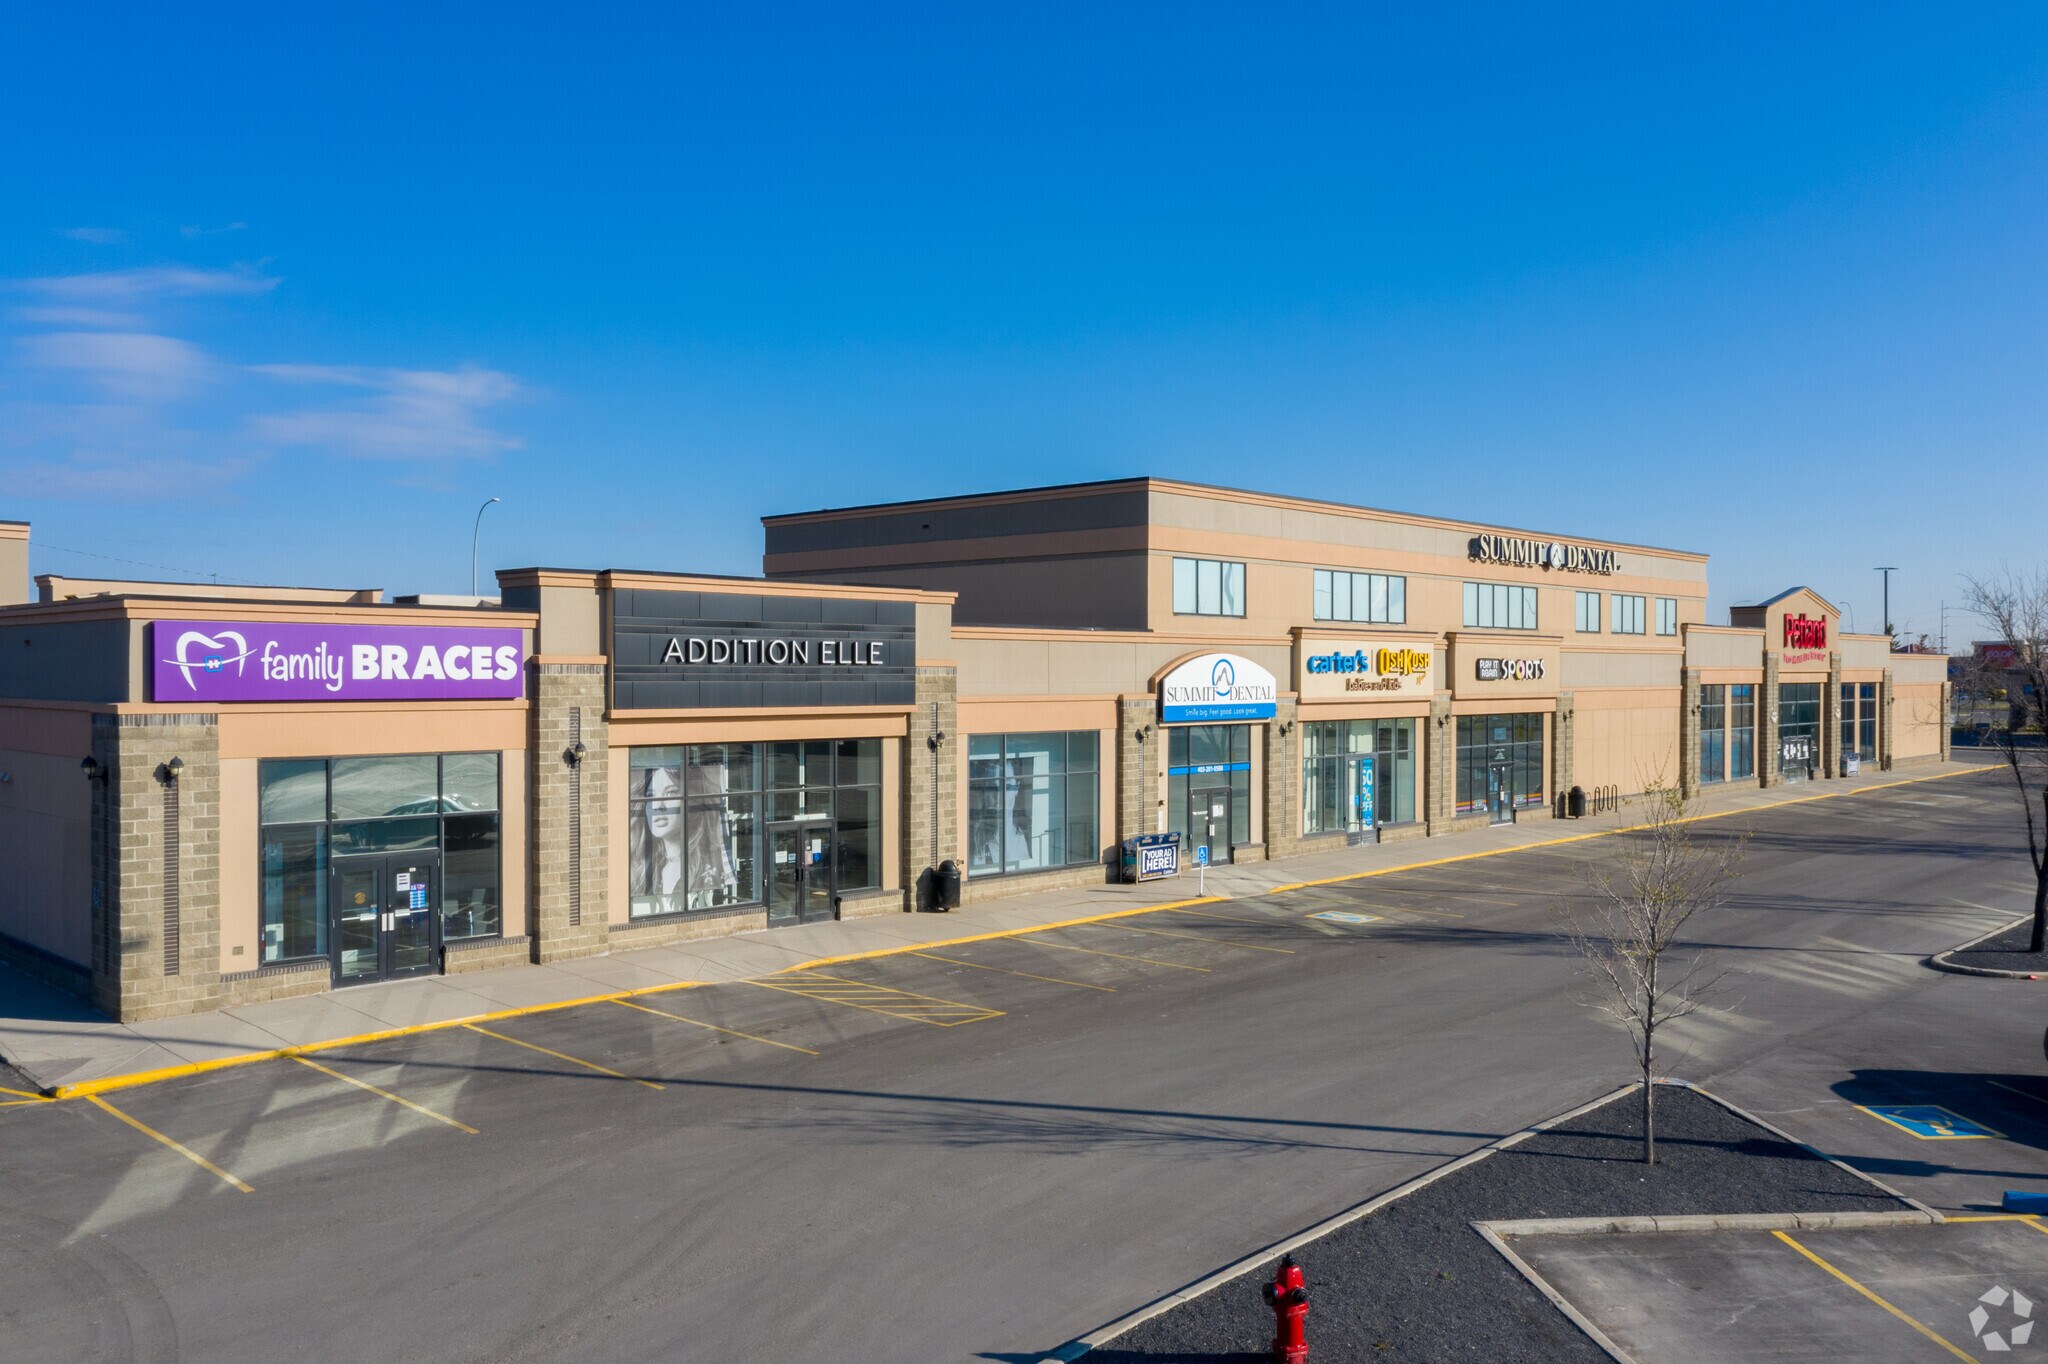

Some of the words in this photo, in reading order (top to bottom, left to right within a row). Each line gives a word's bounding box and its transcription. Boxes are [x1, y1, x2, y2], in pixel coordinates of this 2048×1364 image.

[1480, 533, 1546, 565] SUMMIT
[1567, 545, 1622, 573] DENTAL
[1783, 613, 1827, 650] Petland
[664, 637, 809, 664] ADDITION
[821, 640, 884, 665] ELLE
[260, 640, 344, 692] family
[352, 644, 518, 681] BRACES
[1307, 649, 1369, 674] carter's
[1479, 659, 1492, 669] PLAY
[1493, 659, 1499, 669] IT
[1501, 658, 1546, 680] SPORTS
[1481, 668, 1498, 678] AGAIN
[1167, 686, 1218, 702] SUMMIT
[1230, 685, 1274, 700] DENTAL
[1209, 708, 1219, 716] Feel
[1233, 707, 1245, 715] Look
[1146, 850, 1163, 859] YOUR
[1147, 857, 1172, 870] HERE!
